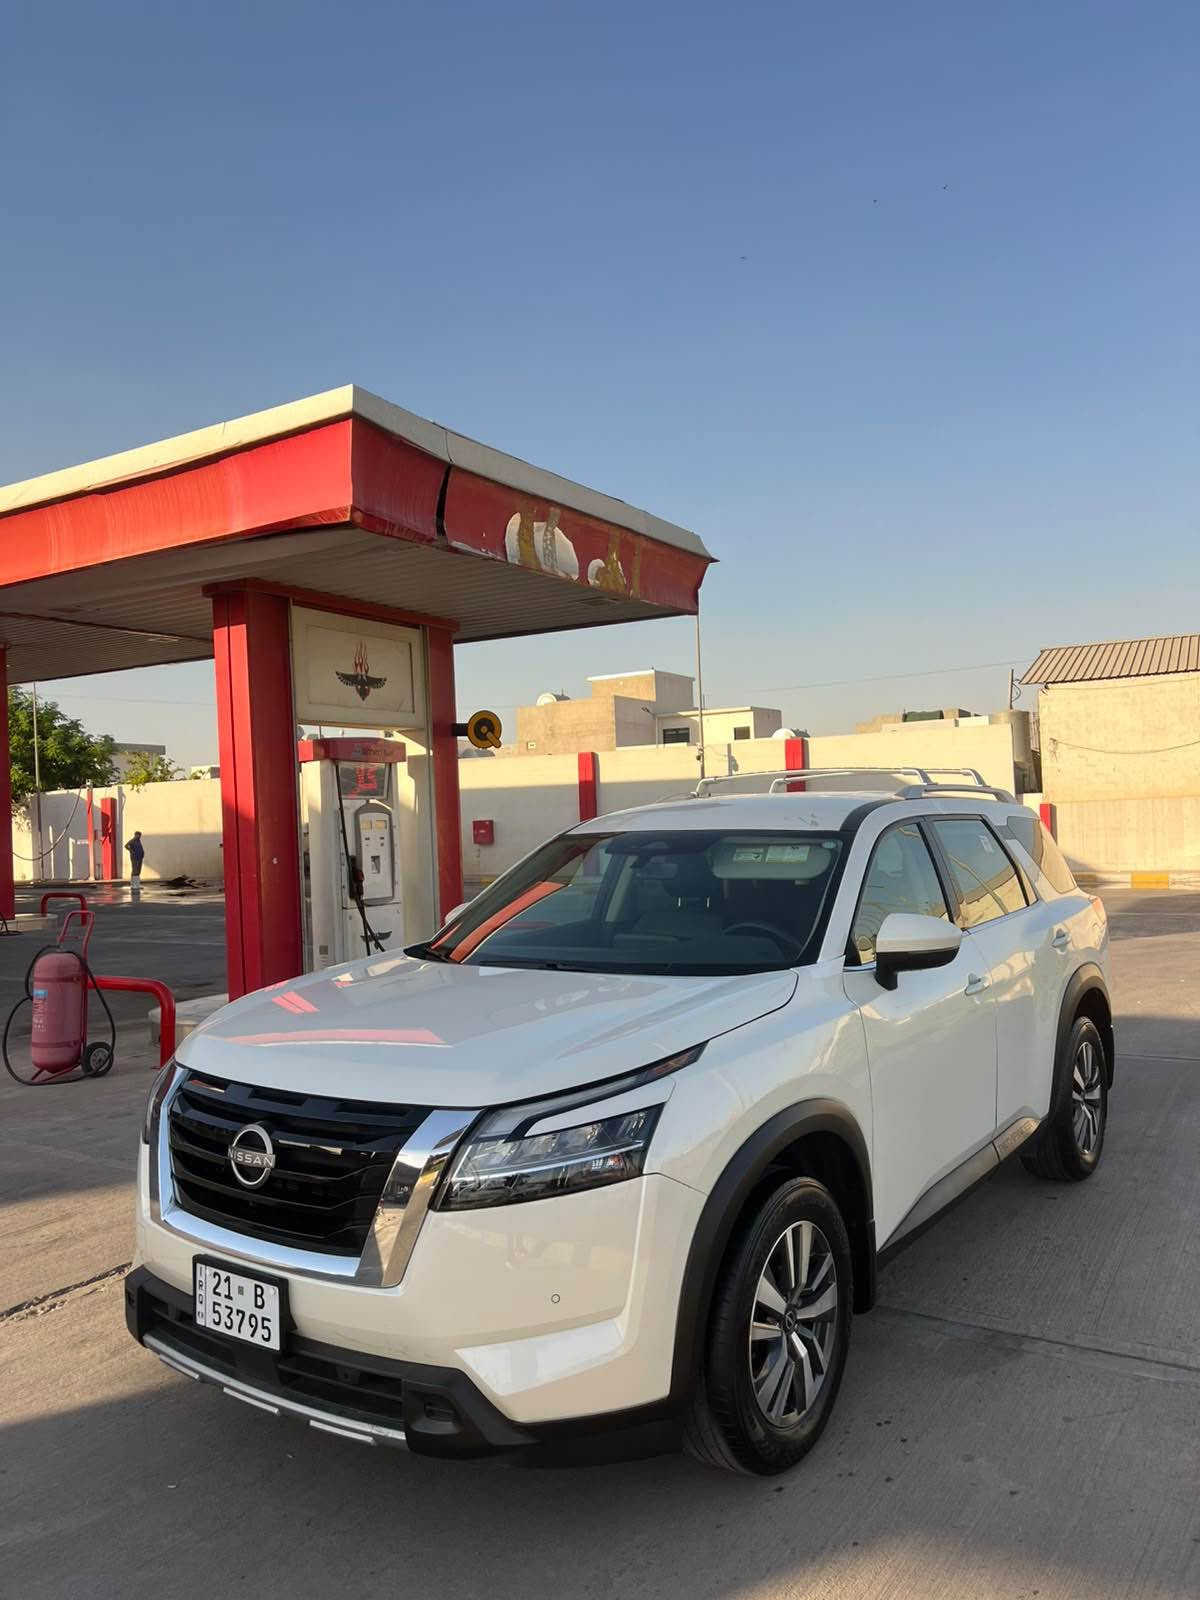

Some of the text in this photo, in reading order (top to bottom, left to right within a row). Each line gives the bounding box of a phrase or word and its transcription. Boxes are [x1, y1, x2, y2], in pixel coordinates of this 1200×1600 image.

[228, 1147, 275, 1168] NISSAN
[213, 1271, 265, 1309] 21 B
[212, 1301, 272, 1342] 53795
